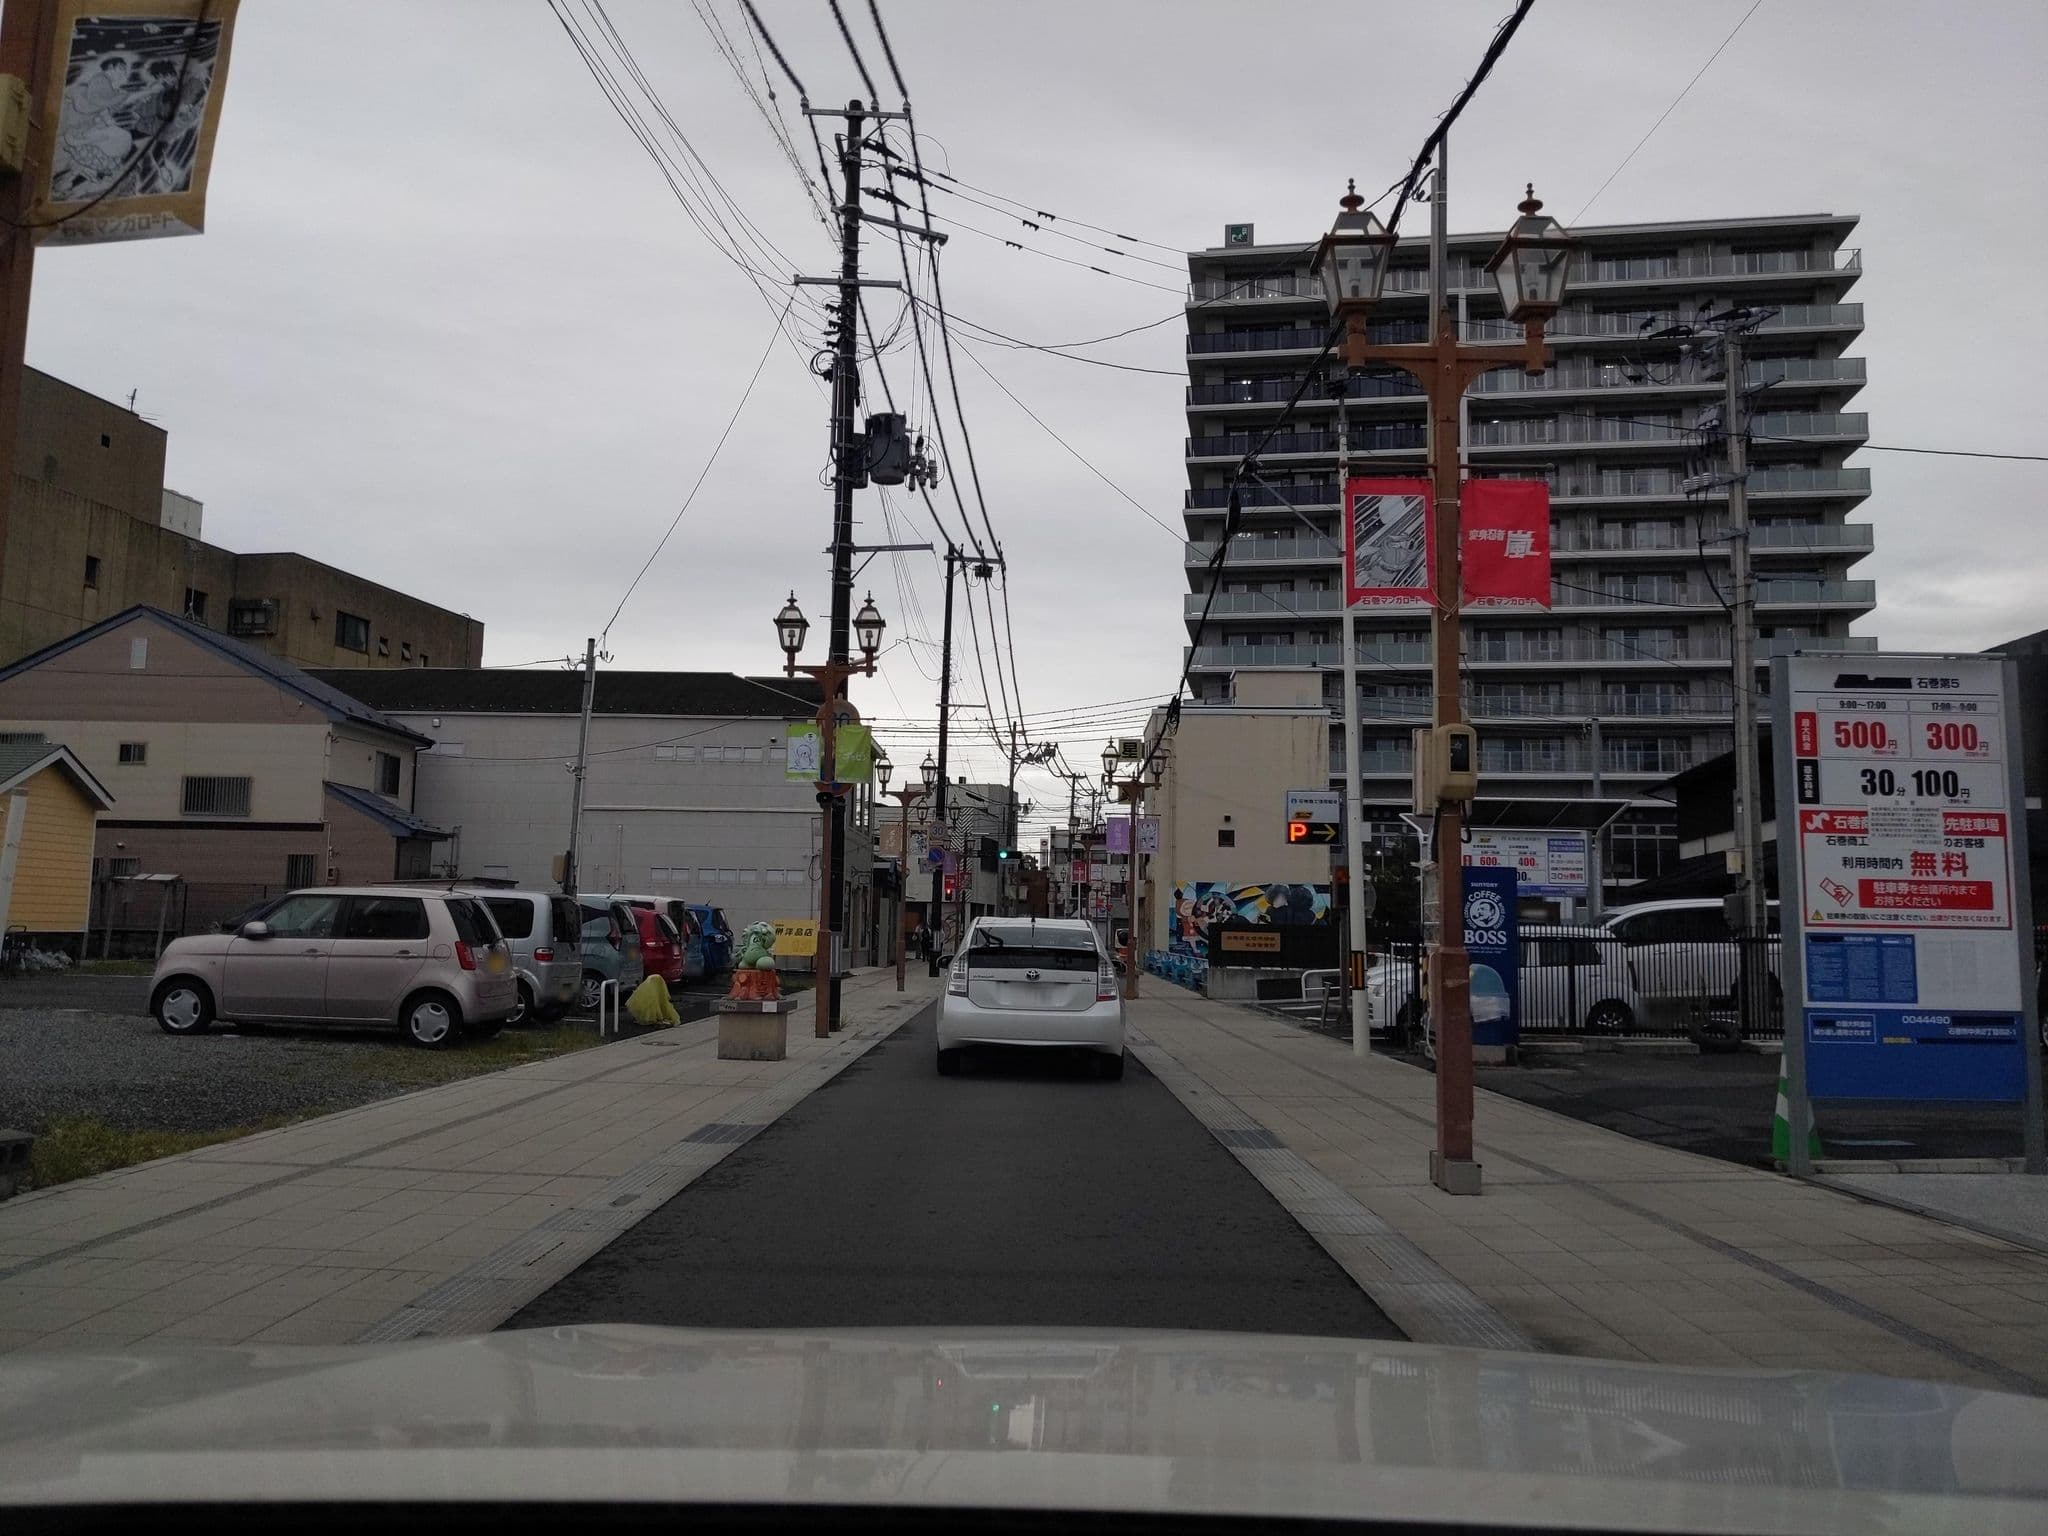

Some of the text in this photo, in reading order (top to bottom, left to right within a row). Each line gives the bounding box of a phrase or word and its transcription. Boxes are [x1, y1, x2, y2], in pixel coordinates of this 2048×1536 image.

[1362, 595, 1422, 605] 石巻マンガロード
[1477, 597, 1537, 606] 石巻マンガロード
[1917, 677, 1960, 688] 石巻第5
[932, 824, 944, 835] 30
[1290, 823, 1307, 841] P
[1842, 851, 1969, 877] 利用時間内 無料
[1468, 890, 1502, 903] COFFEE
[1874, 895, 1942, 907] お持ちください
[1463, 929, 1508, 945] BOSS
